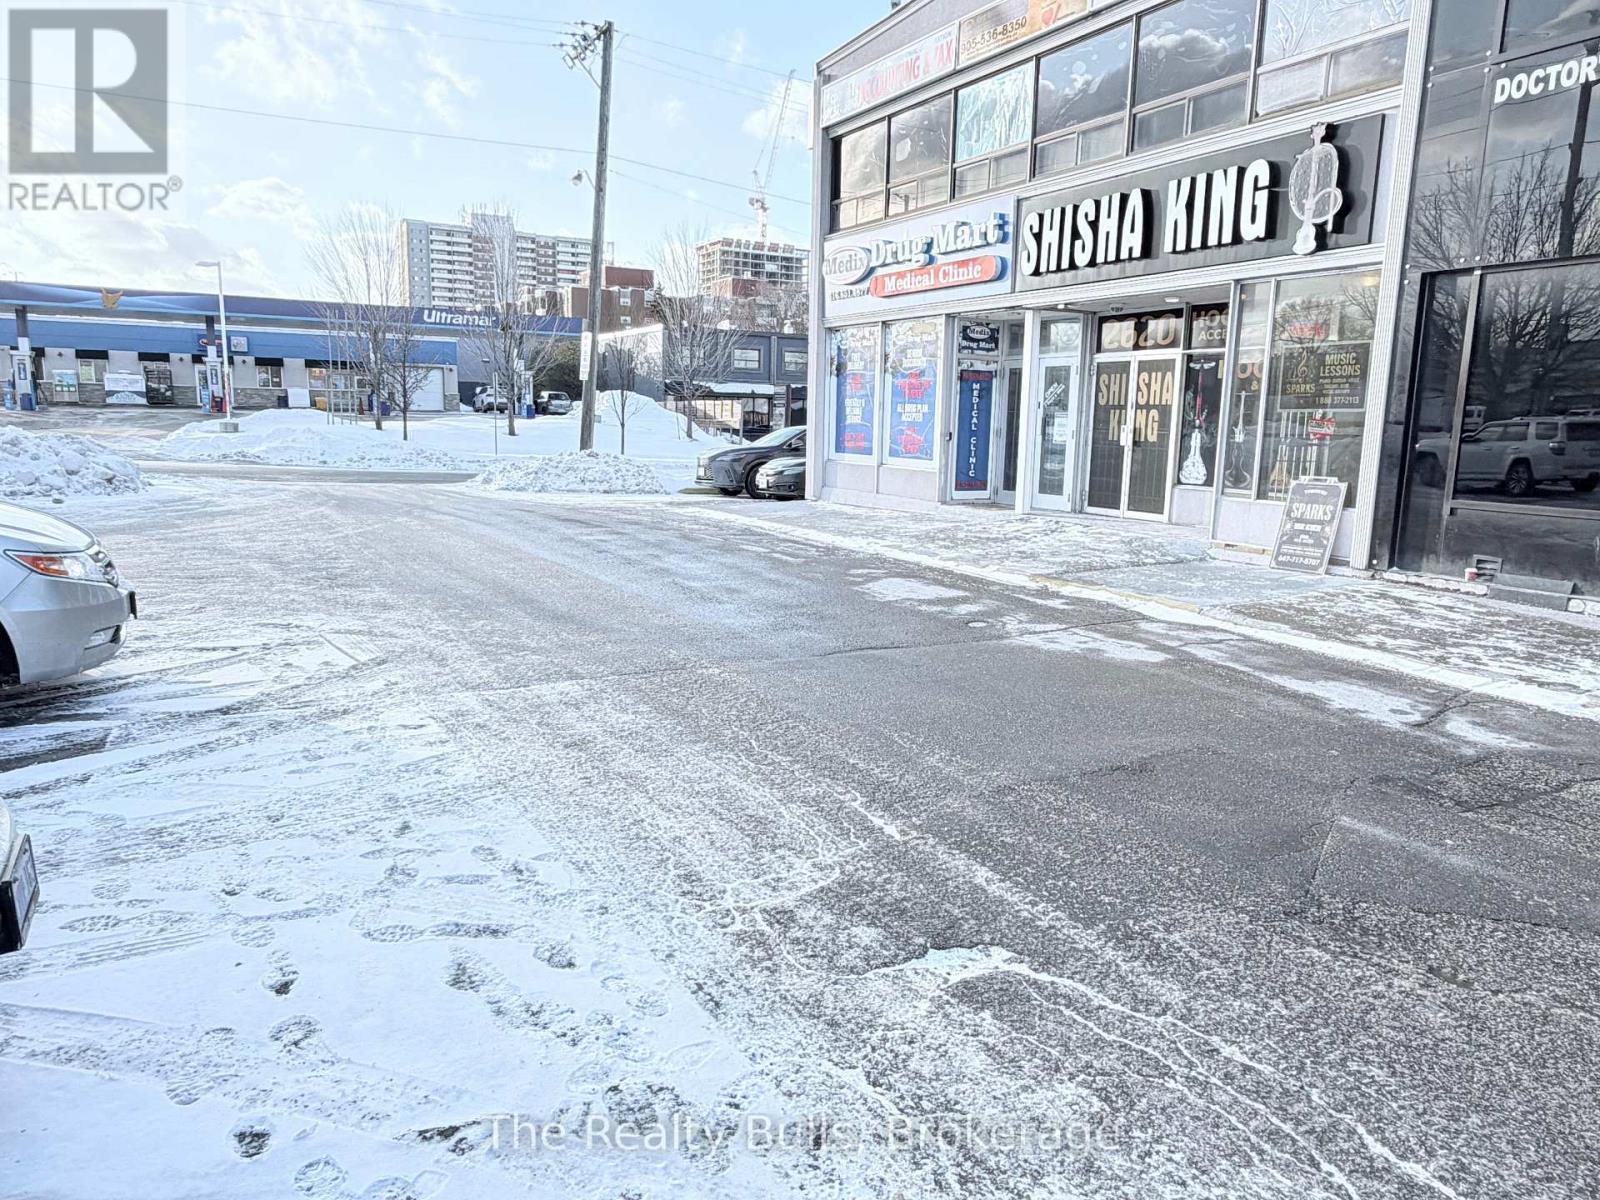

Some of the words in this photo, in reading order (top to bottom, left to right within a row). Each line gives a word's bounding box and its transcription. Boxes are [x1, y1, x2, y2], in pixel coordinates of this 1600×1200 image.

[1494, 54, 1600, 104] DOCTOR
[1021, 188, 1145, 276] SHISHA
[1164, 159, 1271, 253] KING
[869, 235, 932, 266] Drug
[933, 217, 1003, 254] Mart
[825, 253, 867, 275] Medix
[884, 271, 935, 292] Medical
[938, 263, 982, 284] Clinic
[422, 308, 498, 326] Ultramar
[961, 340, 978, 349] Drug
[1325, 352, 1357, 365] MUSIC
[1320, 365, 1361, 377] LESSONS
[1286, 383, 1316, 394] SPARKS
[971, 383, 981, 431] MEDICAL
[968, 436, 977, 478] CLINIC
[1290, 503, 1334, 520] SPARKS
